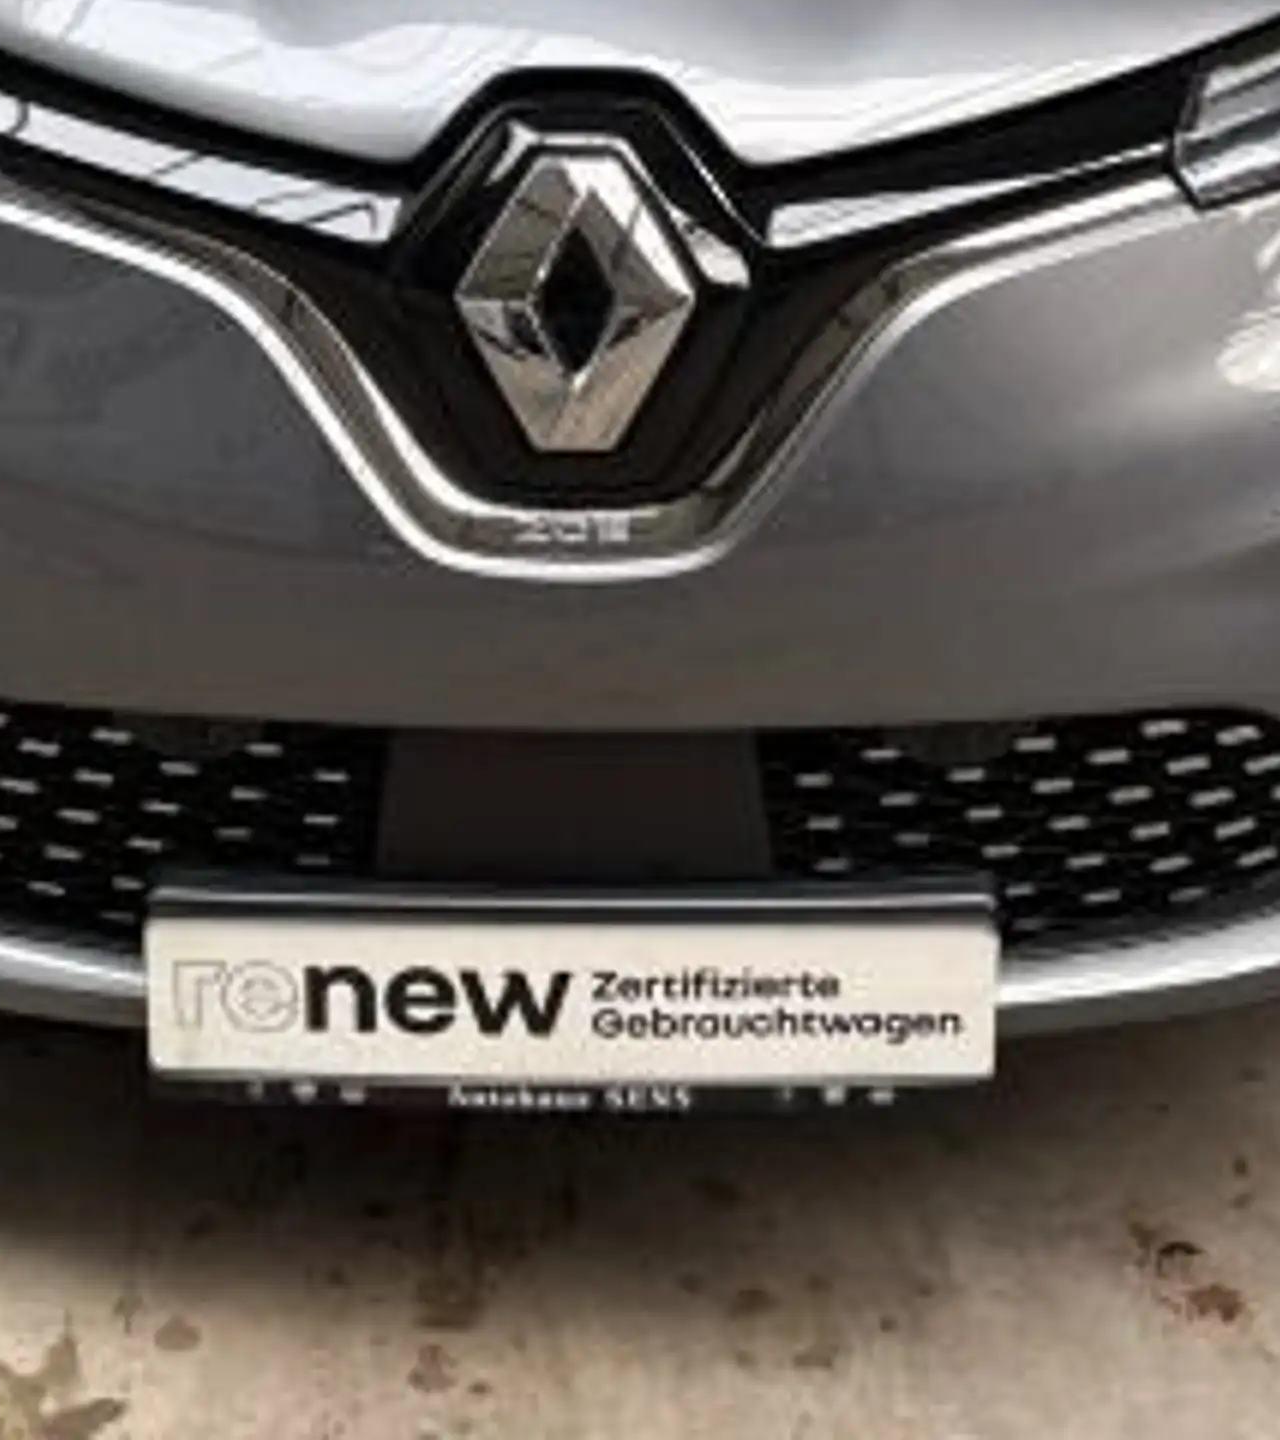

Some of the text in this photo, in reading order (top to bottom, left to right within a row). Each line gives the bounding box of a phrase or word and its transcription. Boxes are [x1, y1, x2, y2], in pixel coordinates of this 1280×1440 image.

[172, 960, 572, 1037] renew
[591, 967, 841, 1002] Zertifizierte
[591, 1007, 963, 1045] Gebrauchtwagen
